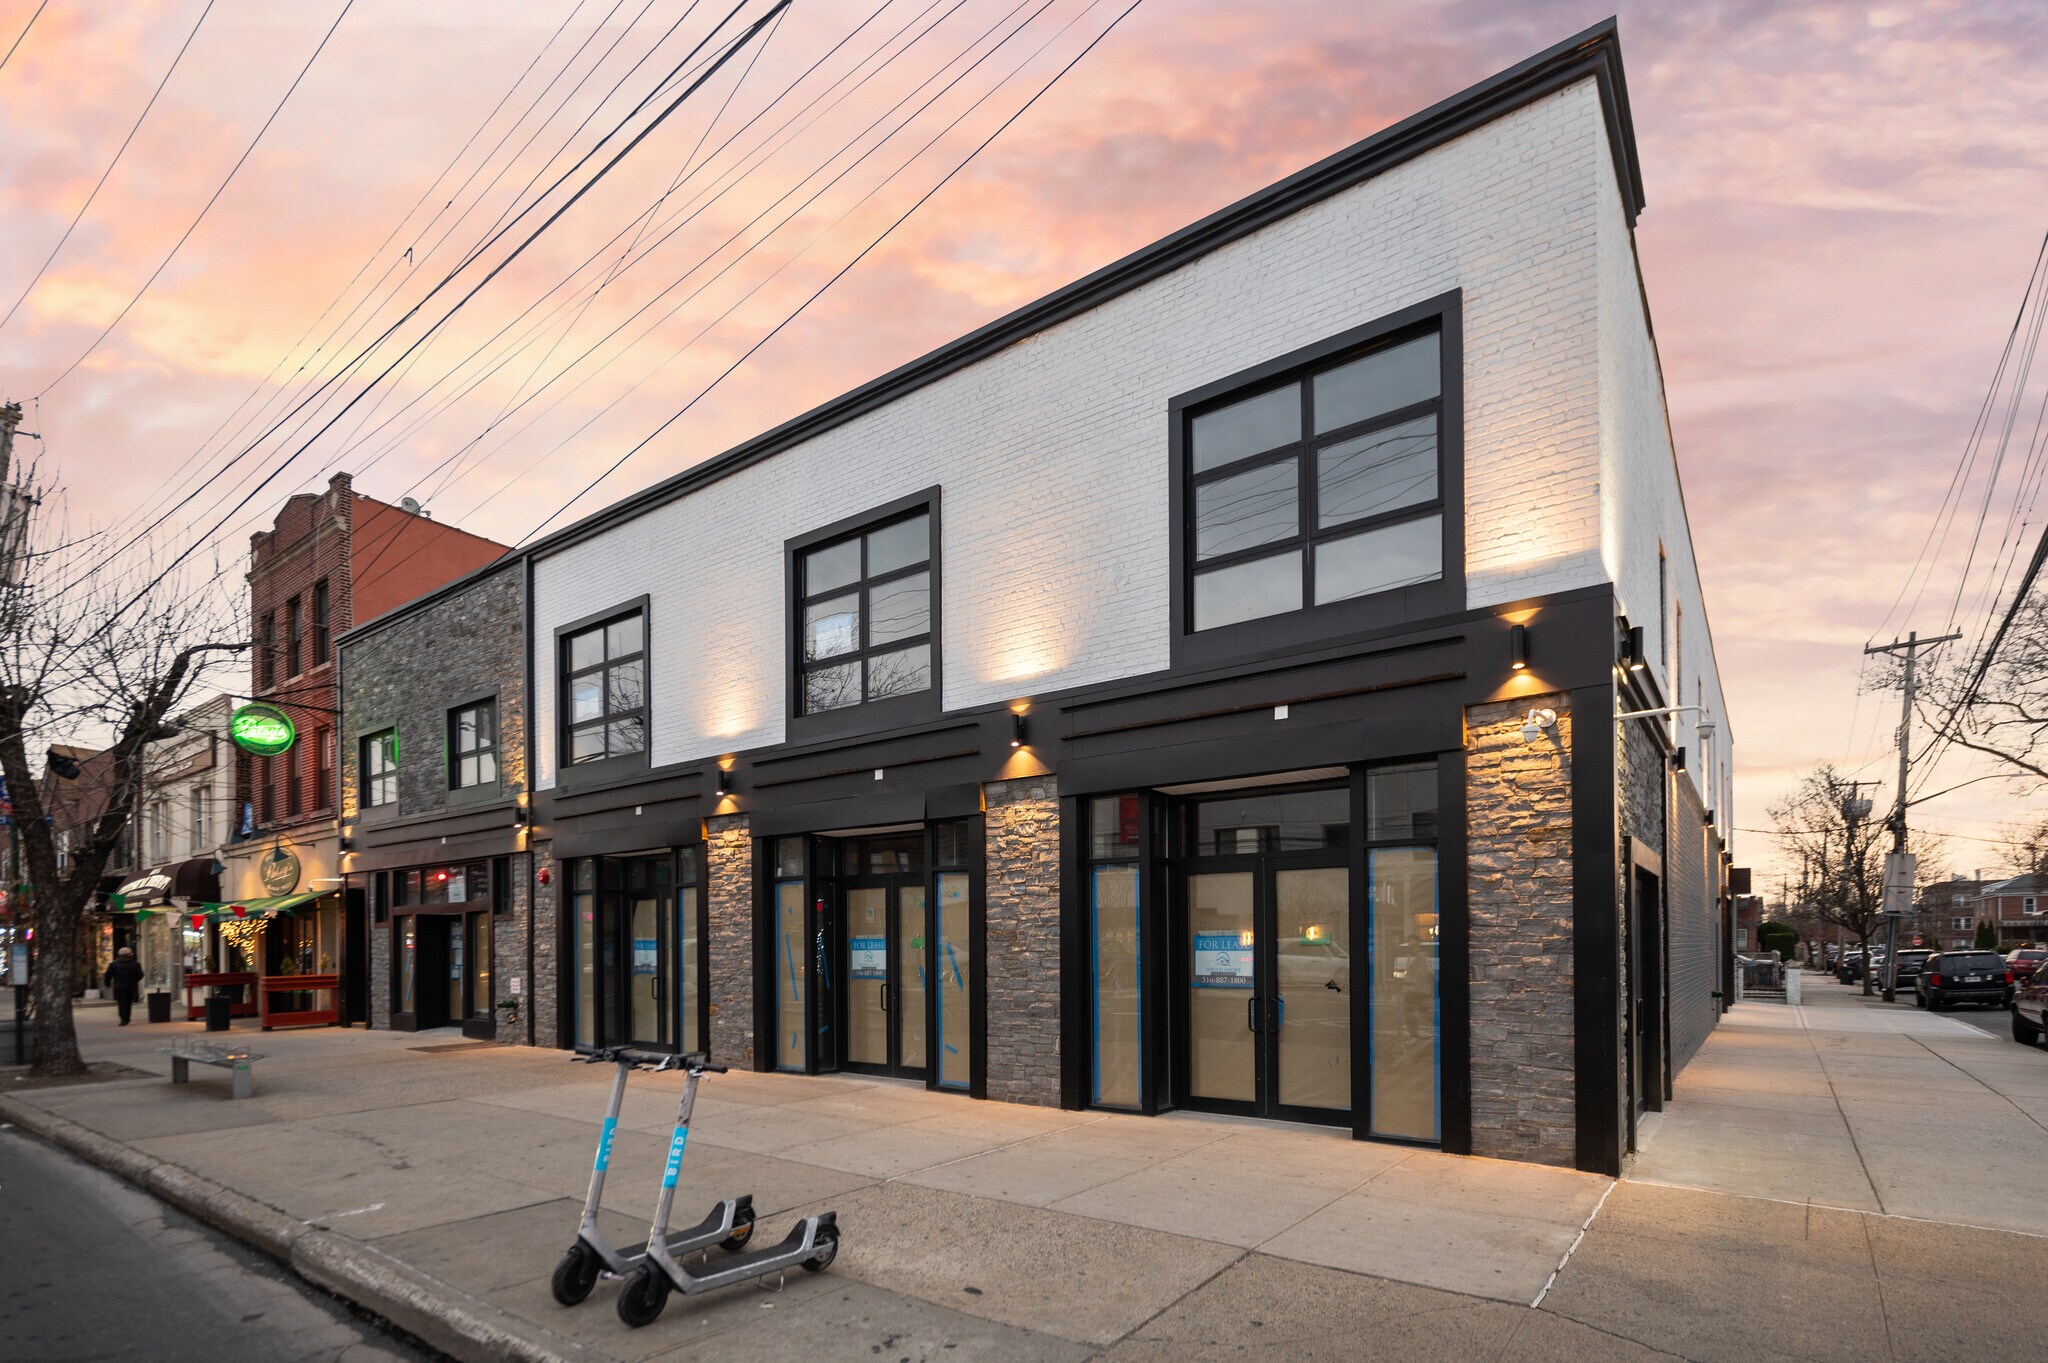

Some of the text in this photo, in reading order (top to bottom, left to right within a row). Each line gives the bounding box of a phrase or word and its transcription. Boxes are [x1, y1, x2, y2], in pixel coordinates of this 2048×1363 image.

[867, 941, 884, 949] LEASE
[1199, 940, 1218, 949] FOR
[1201, 976, 1246, 984] 516-887-1800
[667, 1136, 684, 1176] BIRD
